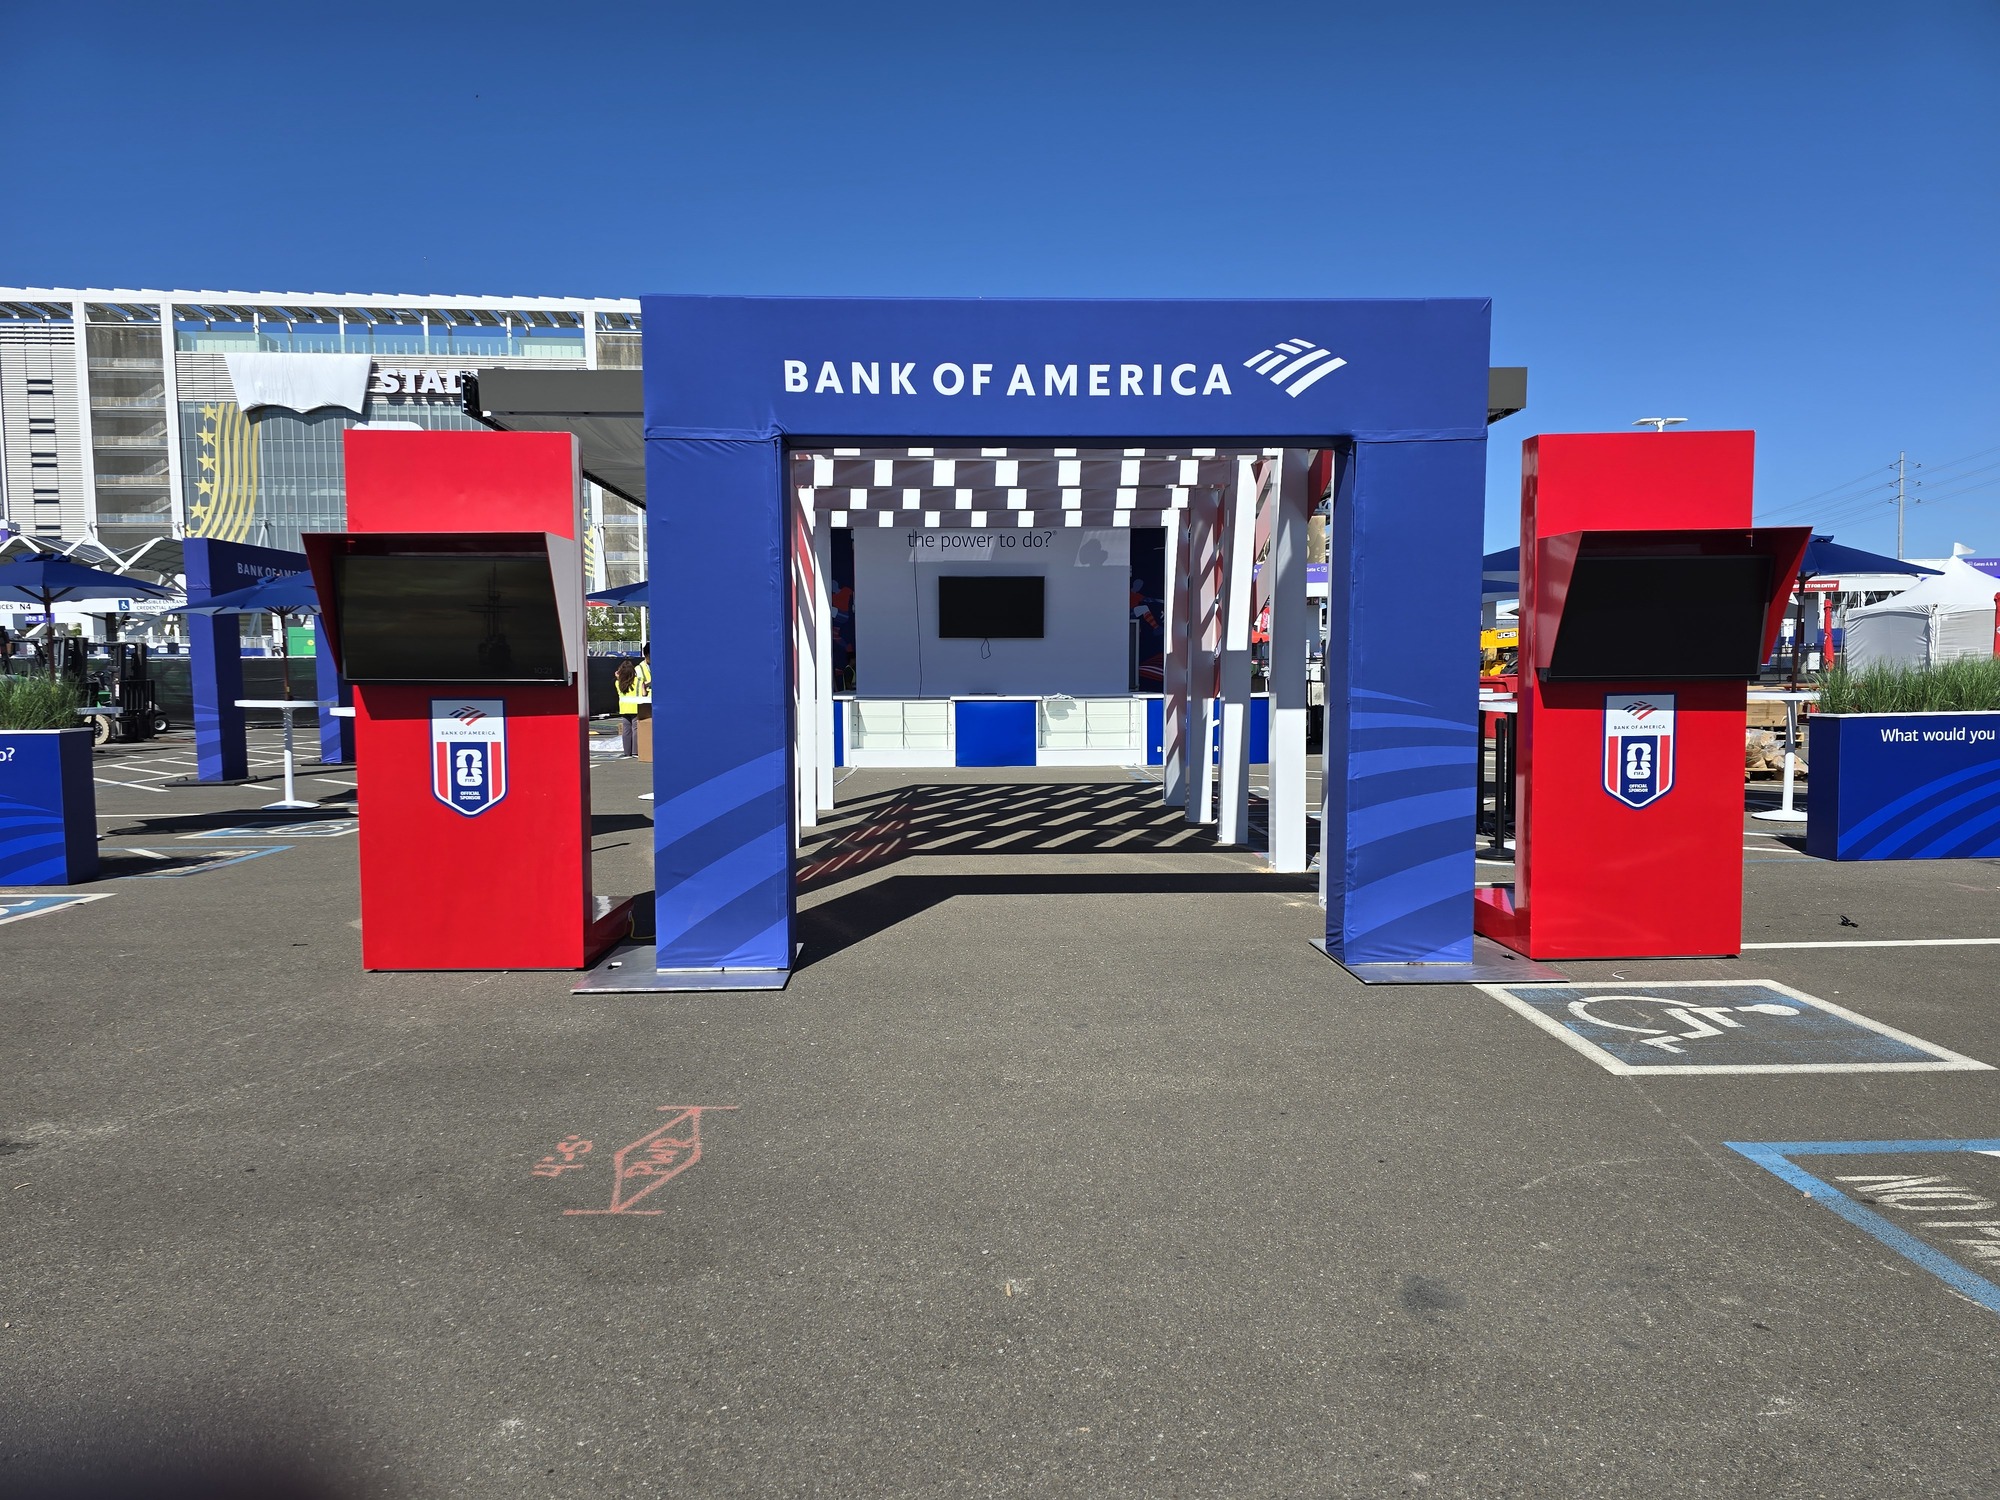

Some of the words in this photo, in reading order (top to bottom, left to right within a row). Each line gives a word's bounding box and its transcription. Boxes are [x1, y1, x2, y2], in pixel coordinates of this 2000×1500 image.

[784, 360, 918, 395] BANK
[932, 362, 993, 396] OF
[1006, 363, 1232, 396] AMERICA
[907, 530, 935, 548] the
[941, 535, 993, 552] power
[999, 533, 1016, 548] to
[237, 562, 264, 577] BANK
[1497, 631, 1517, 639] JCB
[1880, 728, 1919, 743] What
[1922, 727, 1966, 742] would
[1969, 729, 1996, 744] you
